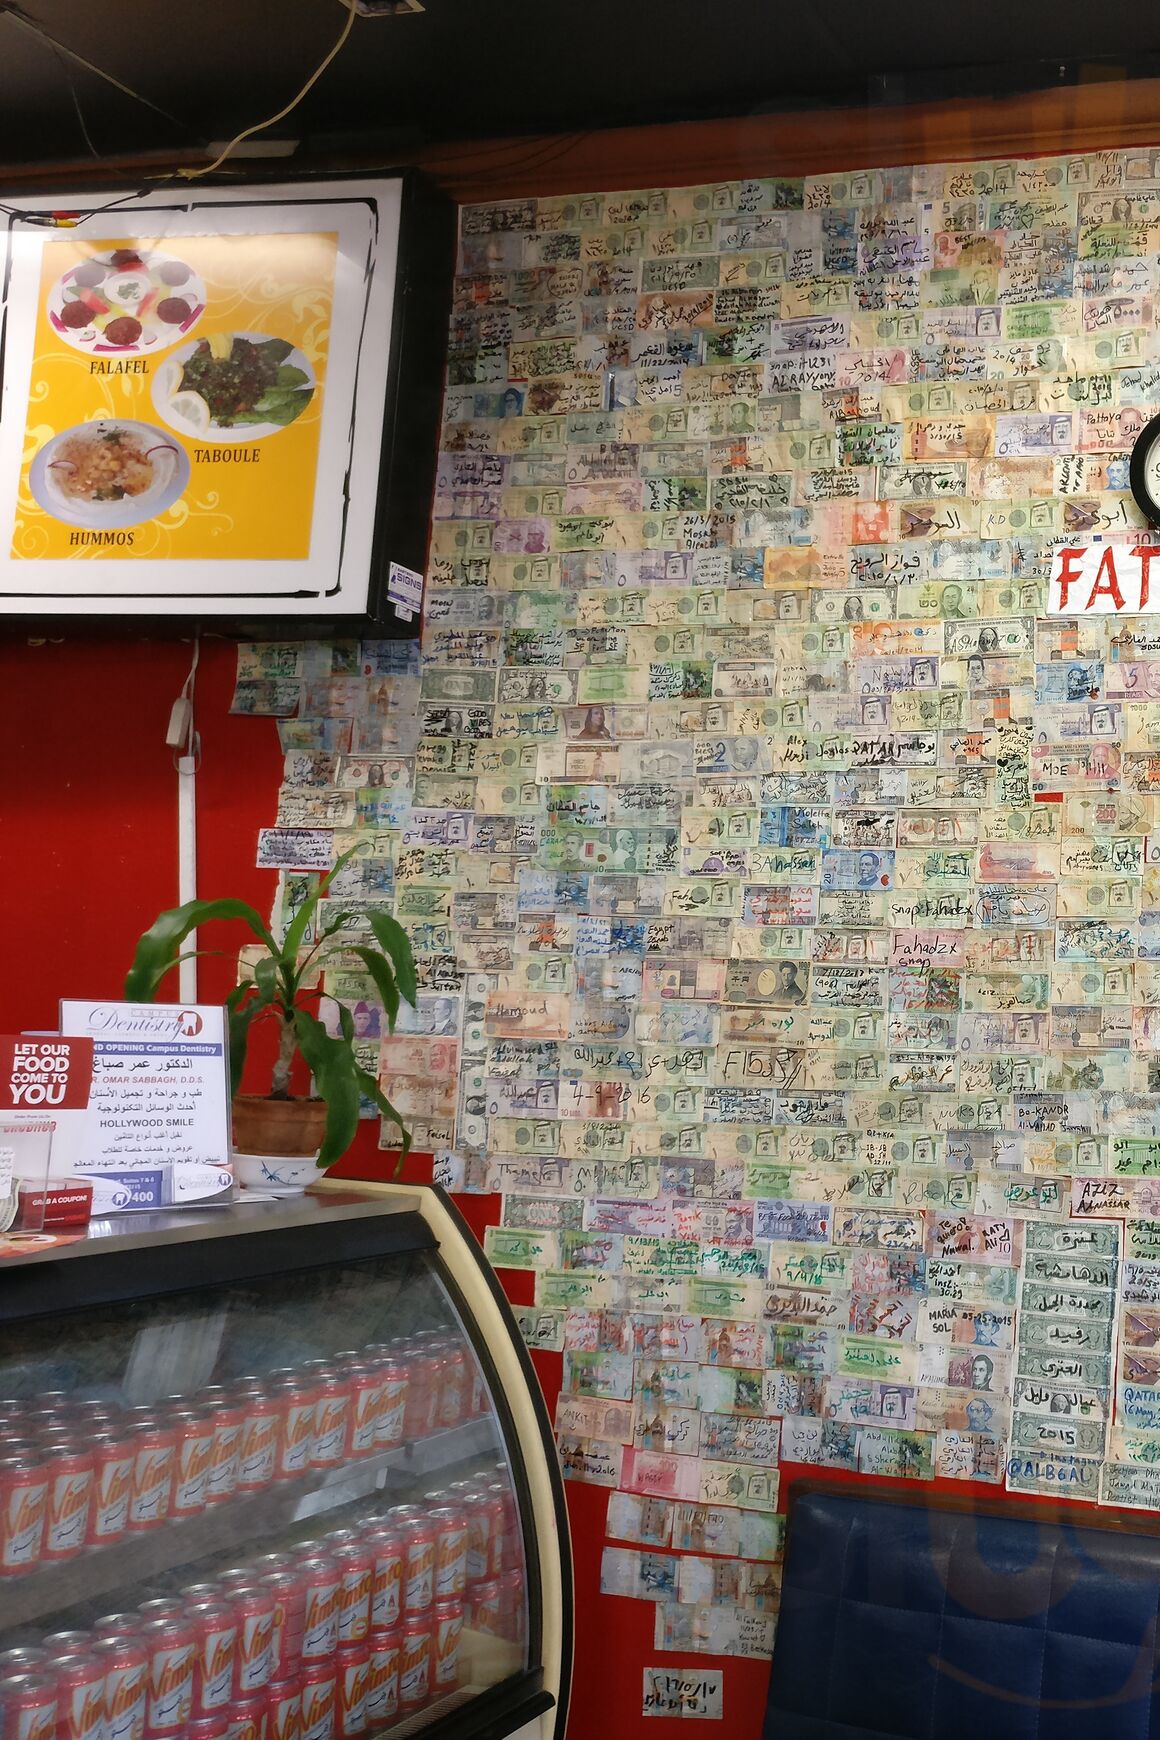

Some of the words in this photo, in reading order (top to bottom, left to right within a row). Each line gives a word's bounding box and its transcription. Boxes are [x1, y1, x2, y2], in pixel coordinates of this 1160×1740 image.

[90, 361, 149, 374] FALAFEL
[195, 449, 260, 463] TABOULE
[70, 532, 134, 546] HUMMOS
[397, 573, 421, 590] SIGNS
[1042, 762, 1069, 777] MOE
[1095, 809, 1117, 818] 200
[87, 1007, 184, 1040] Dentistry
[15, 1044, 38, 1055] LET
[41, 1045, 70, 1055] OUR
[180, 1045, 216, 1054] Dentistry
[13, 1056, 70, 1072] FOOD
[92, 1056, 124, 1073] صباغ
[128, 1062, 150, 1071] عمر
[156, 1059, 193, 1071] الدكتور
[11, 1073, 48, 1083] COME
[52, 1073, 68, 1083] TO
[9, 1084, 66, 1104] YOU
[100, 1119, 163, 1127] HOLLYWOOD
[929, 1308, 957, 1320] MARIA
[933, 1323, 951, 1332] SOL
[1037, 1427, 1075, 1444] 2015
